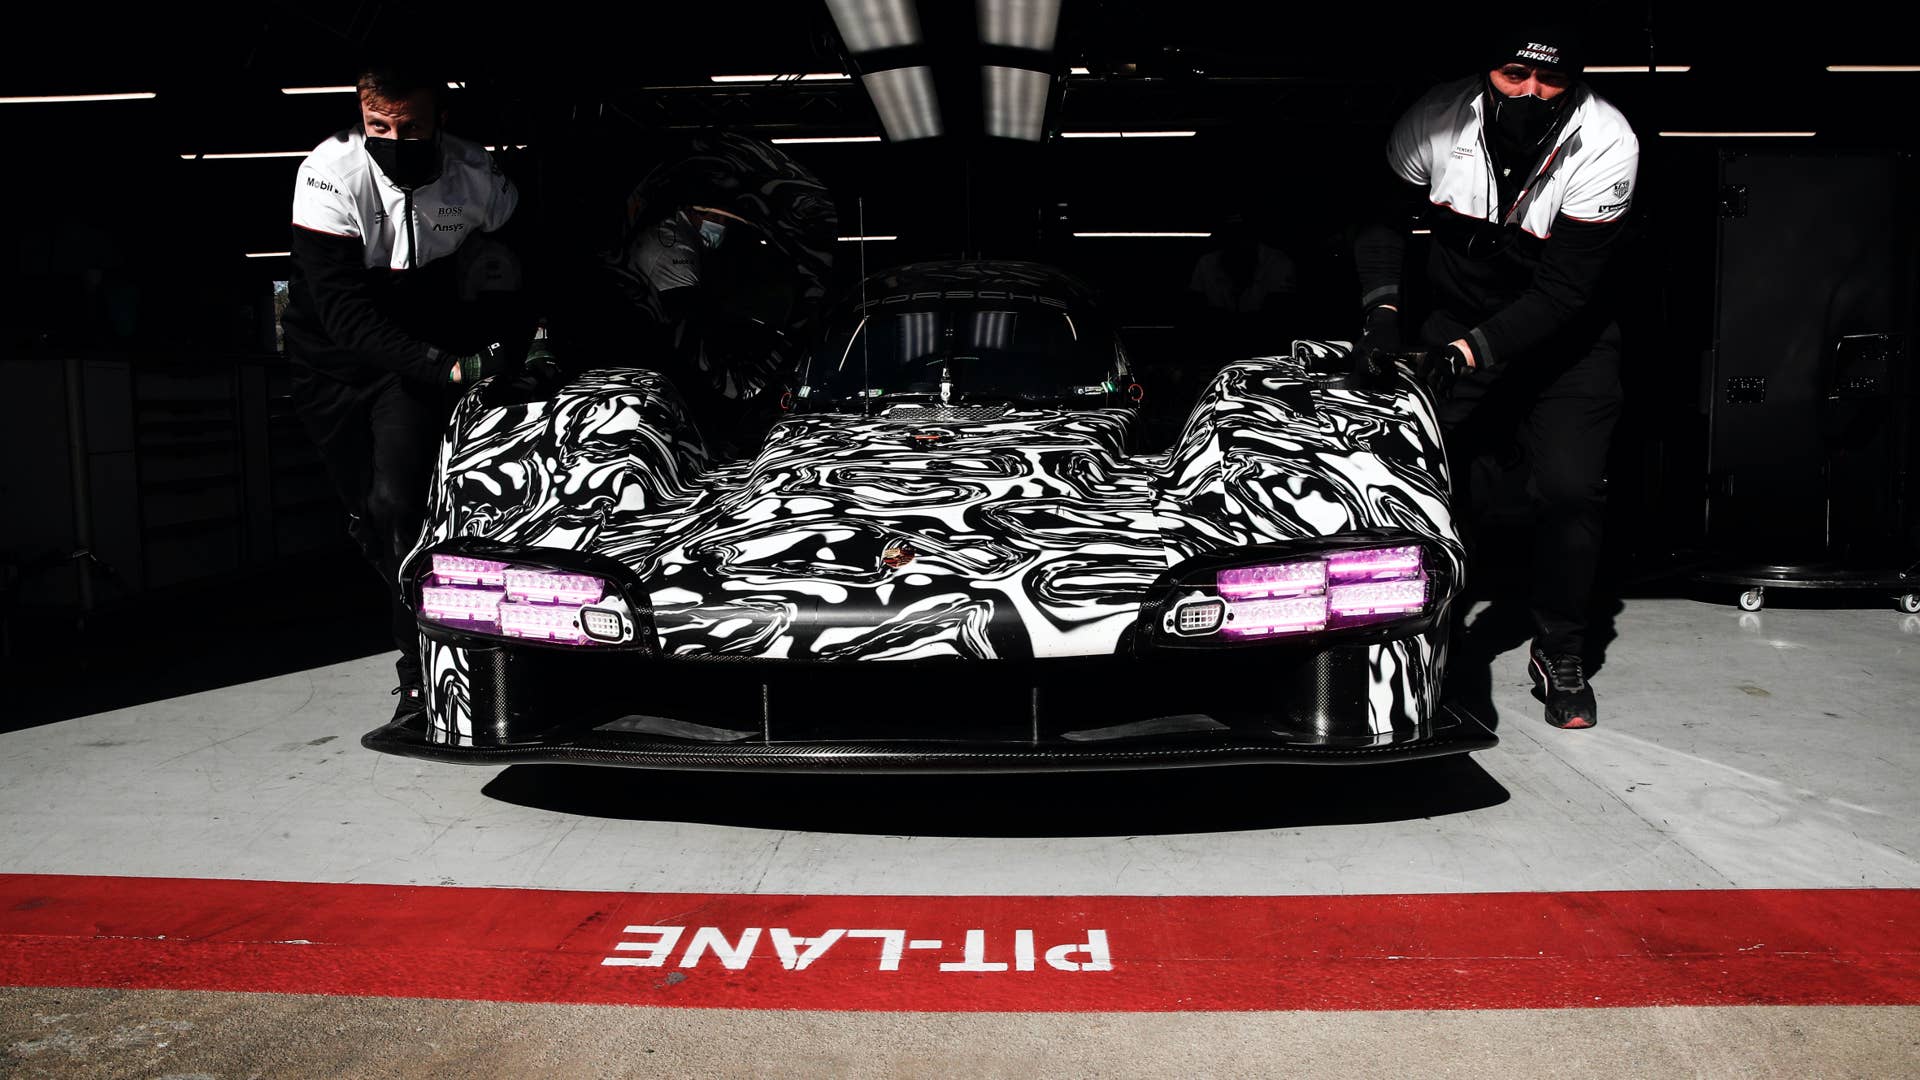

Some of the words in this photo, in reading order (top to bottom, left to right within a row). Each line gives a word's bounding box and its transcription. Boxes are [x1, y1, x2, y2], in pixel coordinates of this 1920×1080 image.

[1526, 42, 1558, 54] TEAM
[1516, 50, 1560, 64] PENSKE
[307, 176, 333, 192] Mobil
[438, 206, 463, 215] BOSS
[433, 223, 464, 232] Ansys
[853, 290, 1069, 312] PORSCHE
[601, 925, 1113, 972] PIT-LANE
